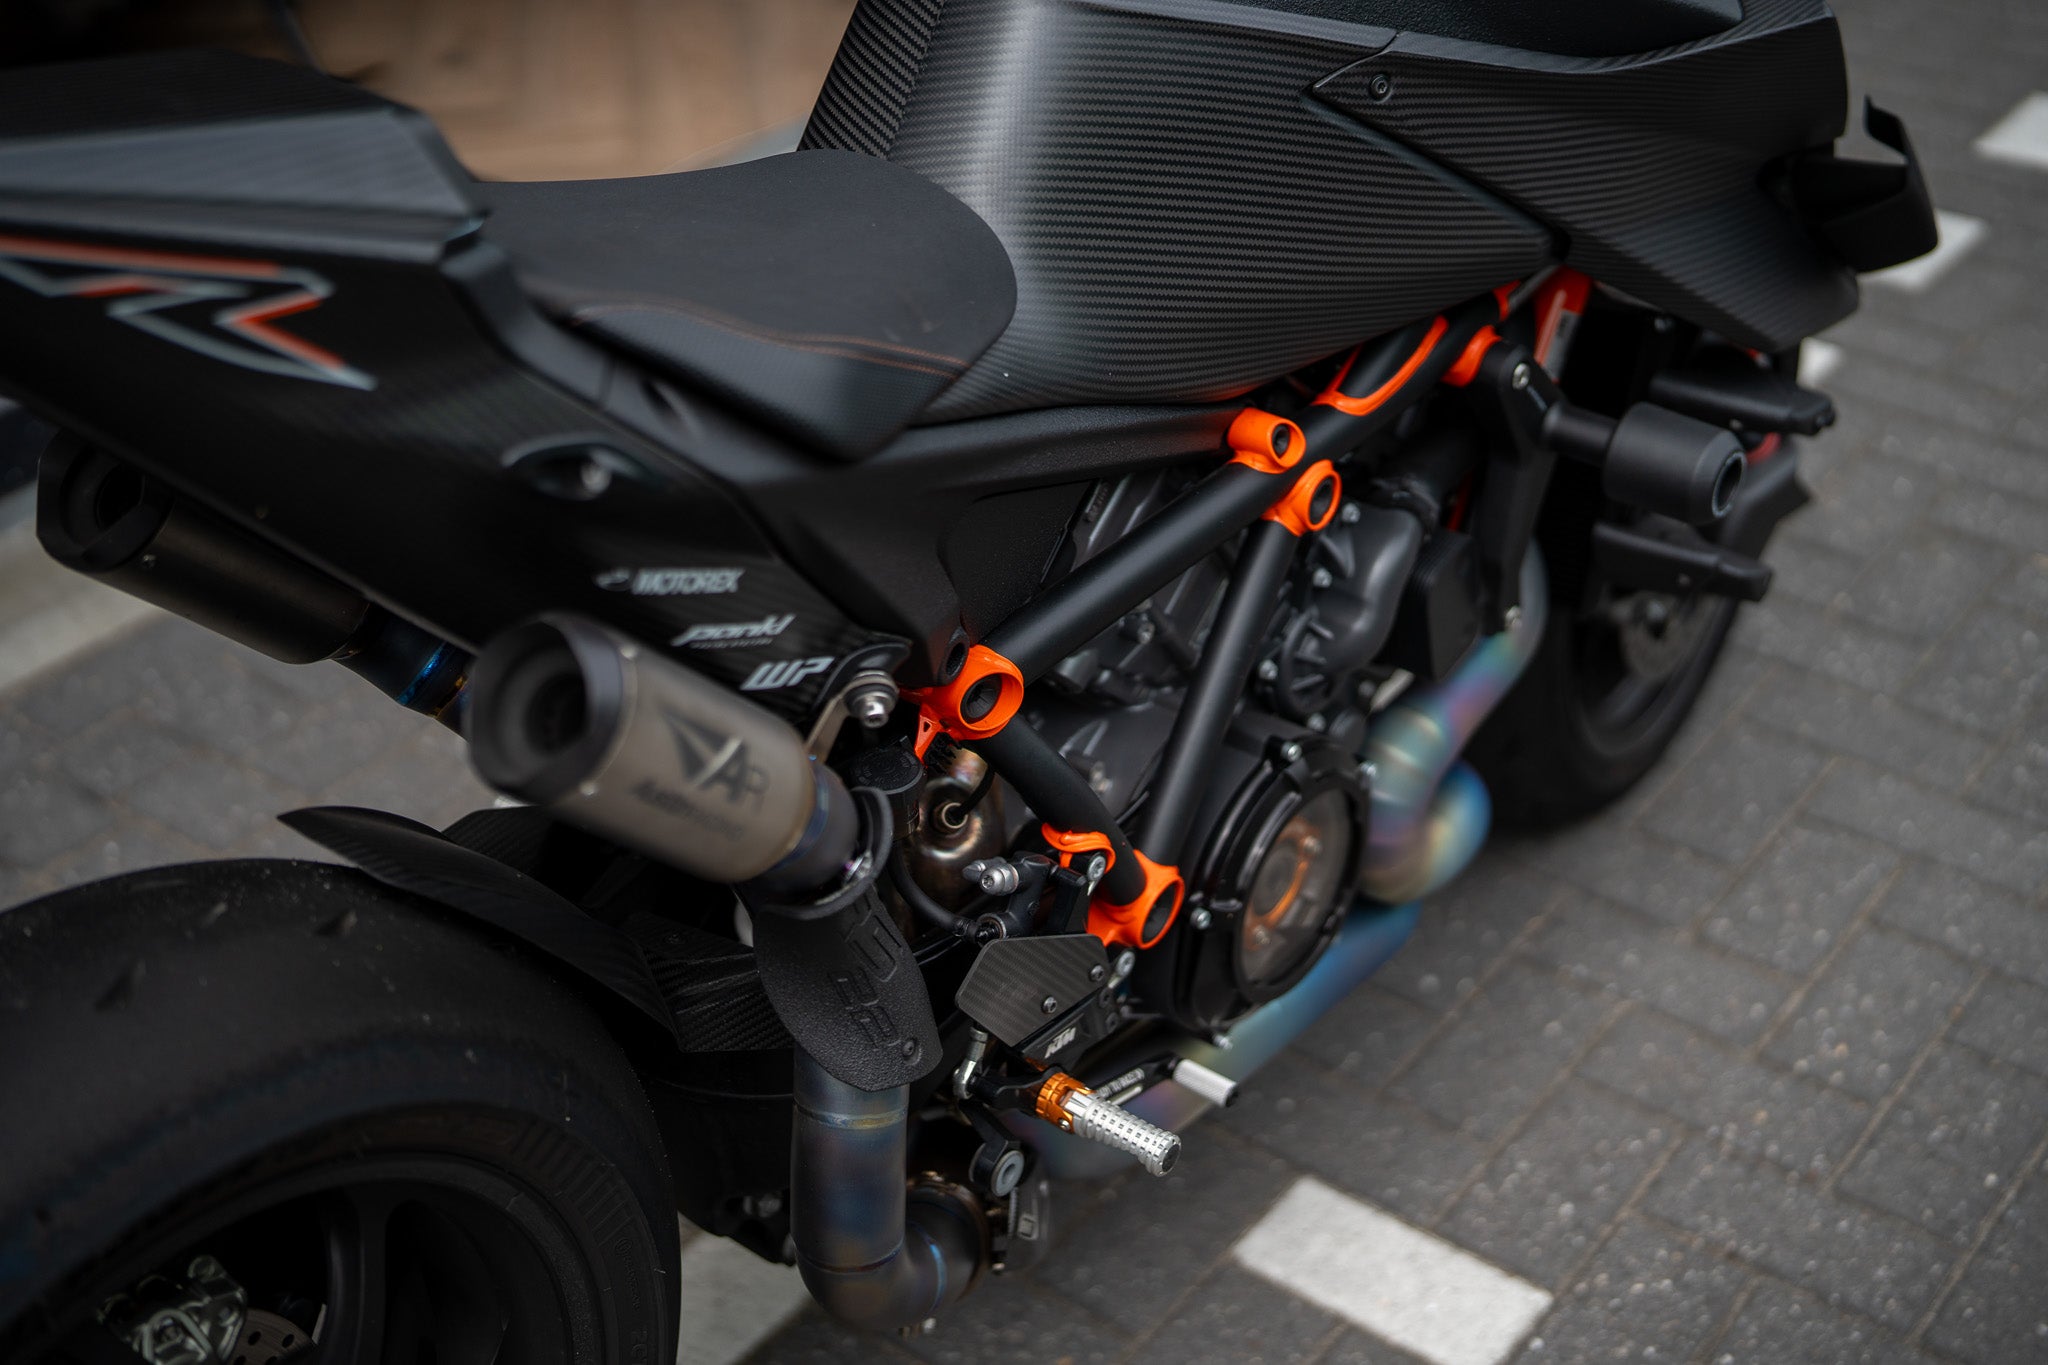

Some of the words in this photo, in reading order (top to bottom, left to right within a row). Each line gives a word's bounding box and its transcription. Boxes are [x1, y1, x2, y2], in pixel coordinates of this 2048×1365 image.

[631, 567, 745, 595] MOTOREX
[740, 655, 836, 691] WP
[1044, 1027, 1076, 1059] KTM
